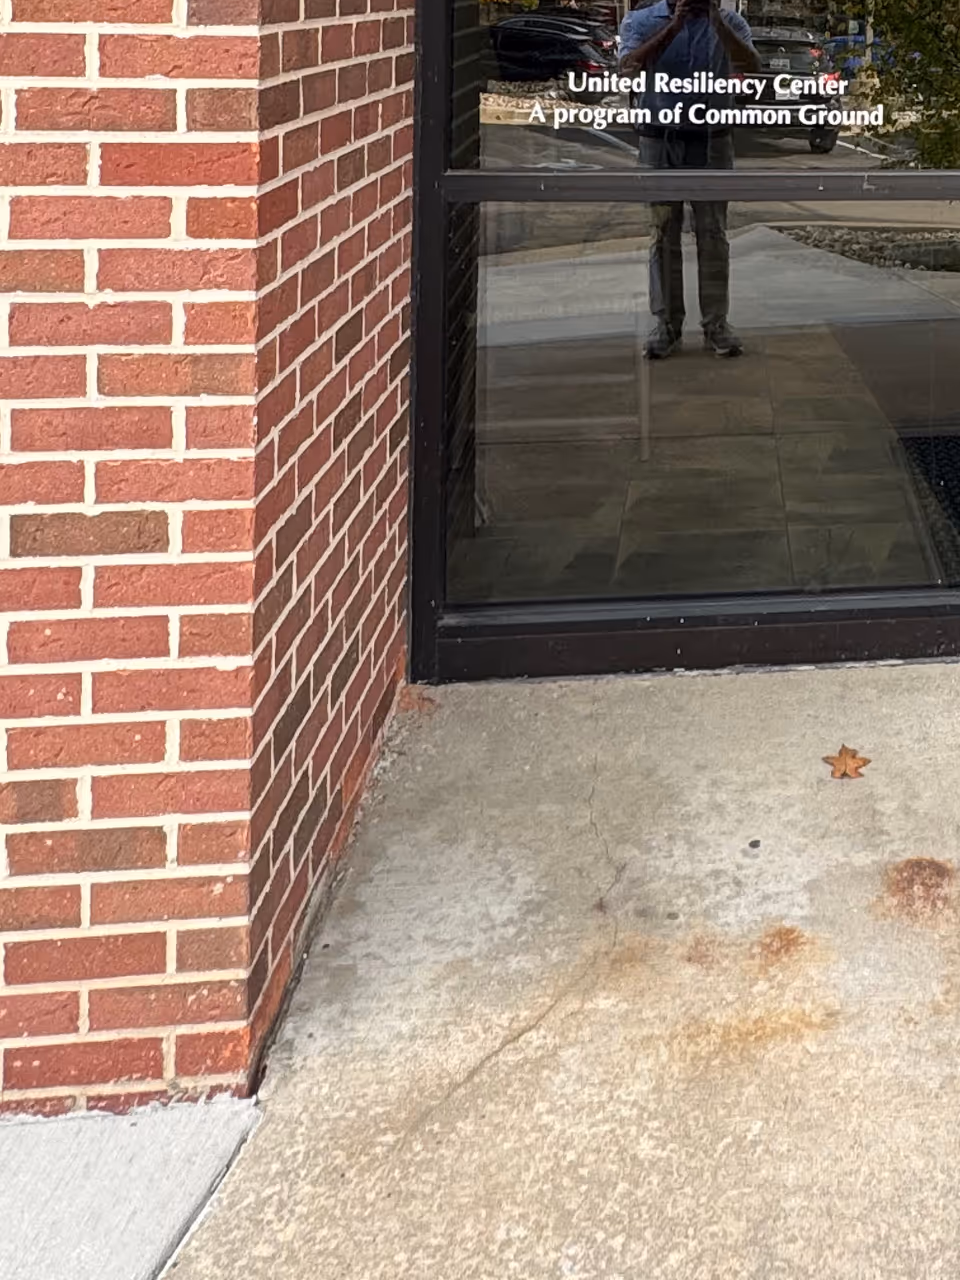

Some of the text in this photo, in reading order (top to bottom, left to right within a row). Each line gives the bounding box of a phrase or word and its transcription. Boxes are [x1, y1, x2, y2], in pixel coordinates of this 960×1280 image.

[568, 71, 647, 94] United
[654, 72, 767, 100] Resiliency
[773, 73, 849, 96] Center
[528, 101, 884, 130] A program of Common Ground
